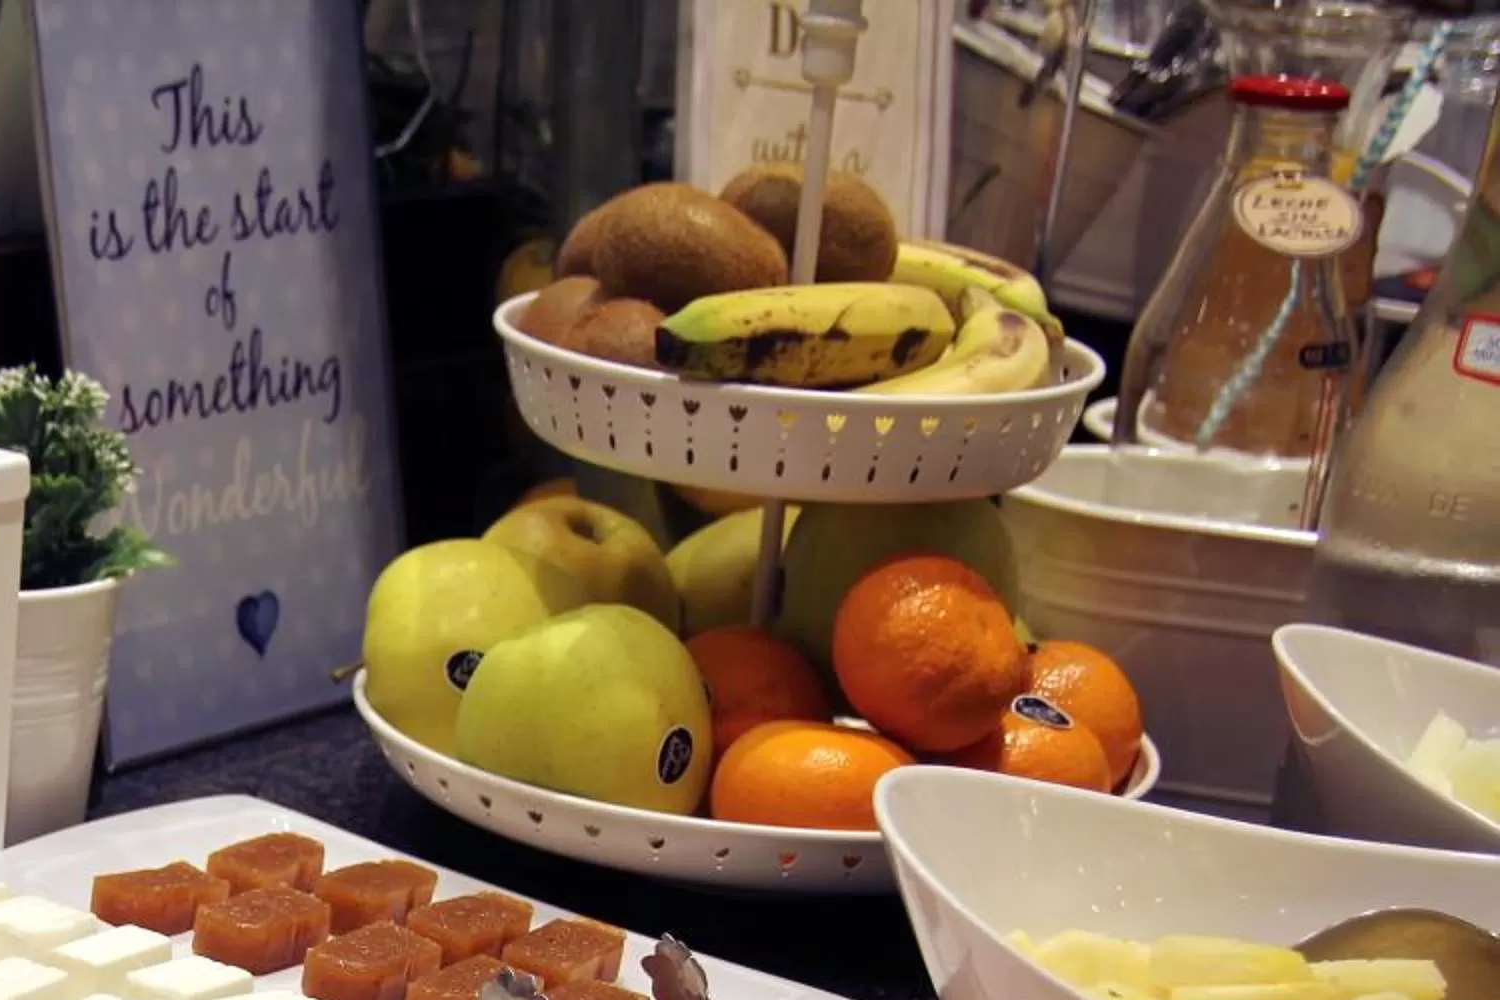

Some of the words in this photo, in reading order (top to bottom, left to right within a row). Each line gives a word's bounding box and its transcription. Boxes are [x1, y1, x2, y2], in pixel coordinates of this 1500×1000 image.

[151, 62, 263, 154] This
[89, 209, 134, 262] is
[143, 167, 219, 253] the
[231, 160, 340, 243] start
[204, 251, 238, 330] of
[119, 328, 342, 436] something
[88, 411, 369, 540] Wonderful
